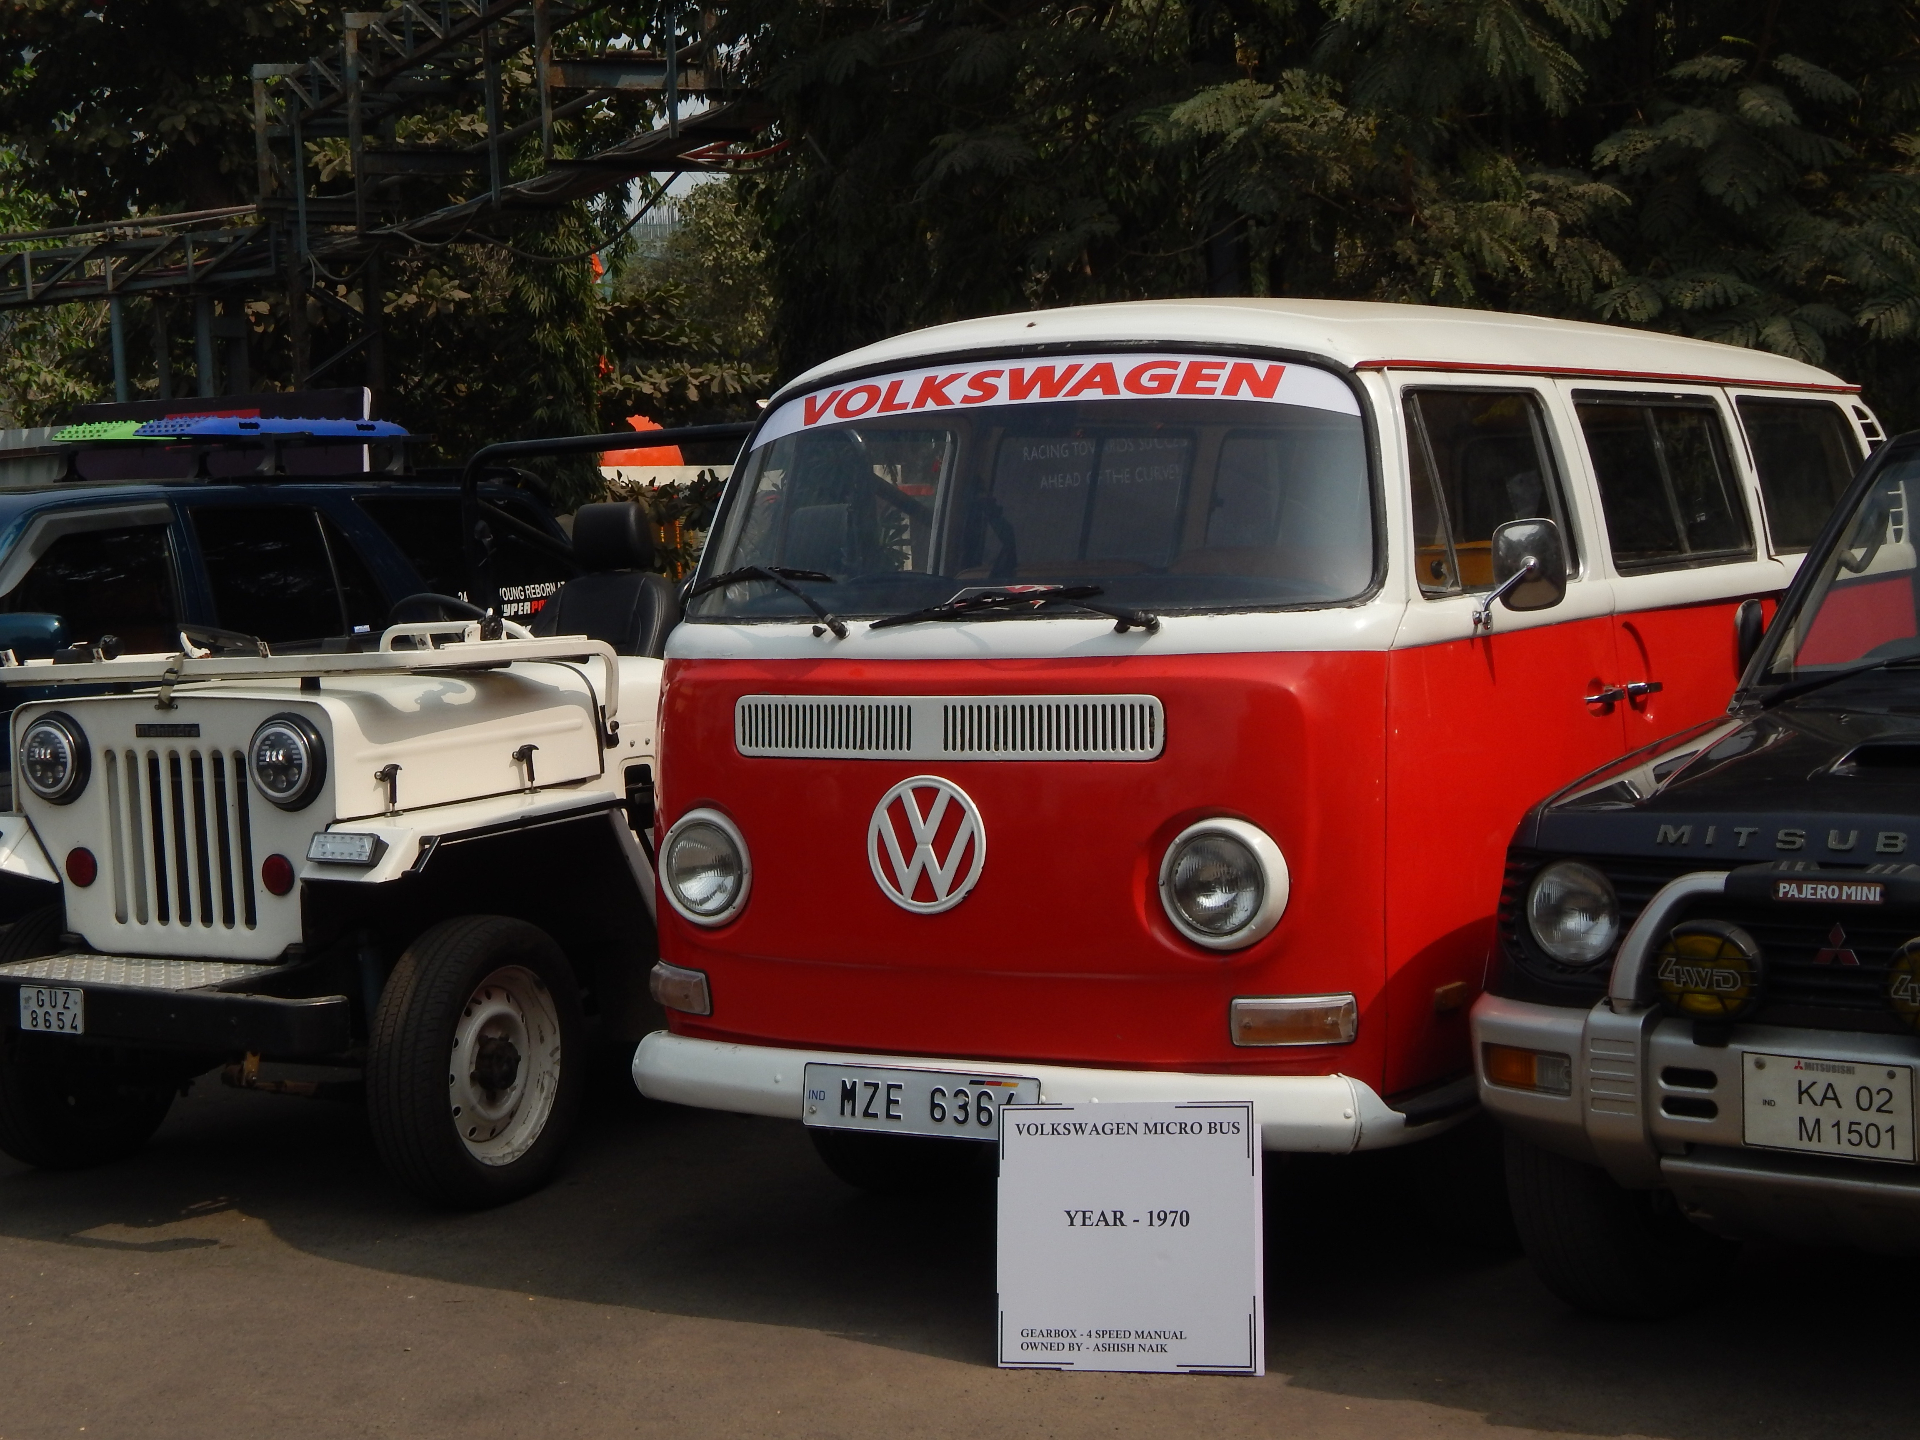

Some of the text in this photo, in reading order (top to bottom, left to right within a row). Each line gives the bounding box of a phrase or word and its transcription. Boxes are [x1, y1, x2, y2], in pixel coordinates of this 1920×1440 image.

[803, 360, 1285, 426] VOLKSWAGEN
[1022, 443, 1069, 461] RACING
[1071, 438, 1134, 457] TOWRDS
[1040, 472, 1081, 489] AHEAD
[1104, 468, 1131, 485] THE
[525, 582, 556, 599] REBORN
[1778, 883, 1881, 902] PAJERO MINI
[1658, 957, 1741, 992] 4WD
[36, 989, 70, 1010] GUZ
[31, 1009, 78, 1032] 8654
[1804, 1061, 1856, 1076] MITSUBISHI
[808, 1089, 826, 1101] IND
[840, 1078, 904, 1121] MZE
[1762, 1098, 1776, 1107] IND
[1798, 1079, 1894, 1114] KA 02
[1015, 1121, 1241, 1136] VOLKSWAGEN MICRO BUS
[1798, 1116, 1895, 1150] M 1501
[1063, 1209, 1128, 1227] YEAR
[1147, 1209, 1190, 1228] 1970
[1020, 1328, 1077, 1339] GEARBOX
[1086, 1329, 1093, 1339] 4
[1095, 1329, 1132, 1340] SPEED
[1134, 1330, 1187, 1340] MANUAL
[1020, 1341, 1065, 1352] OWNED
[1068, 1342, 1083, 1352] BY
[1092, 1343, 1135, 1353] ASHISH
[1138, 1343, 1168, 1353] NAIK
